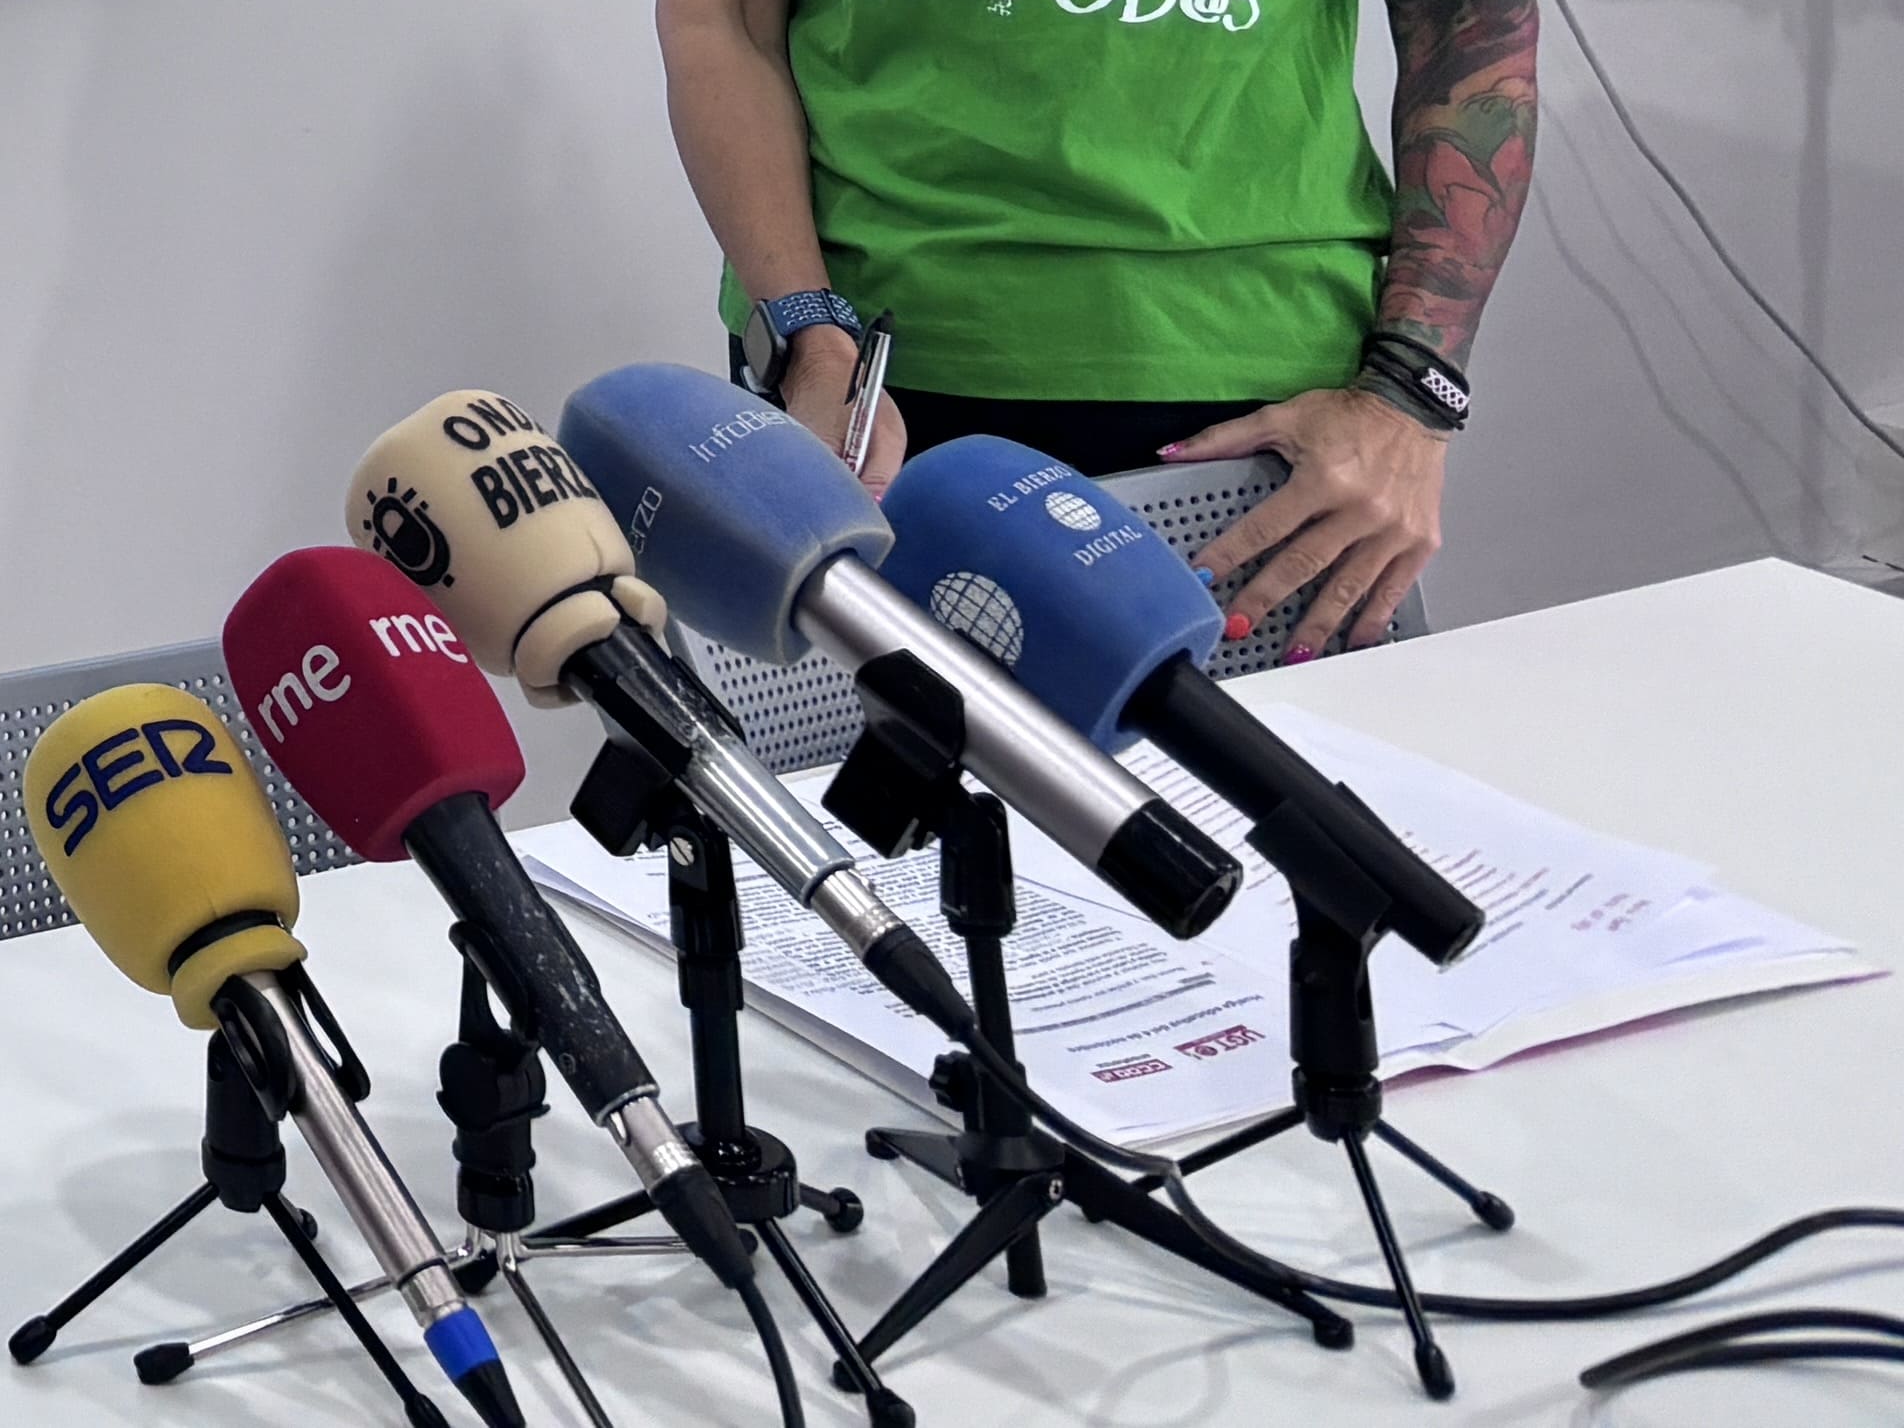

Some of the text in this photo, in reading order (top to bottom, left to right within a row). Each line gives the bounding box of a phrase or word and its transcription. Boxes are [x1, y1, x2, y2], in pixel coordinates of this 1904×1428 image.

[443, 396, 545, 451] OND
[471, 445, 600, 529] BIERZ
[987, 464, 1073, 512] EL BIERZO
[1072, 525, 1143, 567] DIGITAL
[369, 613, 469, 664] rne
[258, 644, 352, 744] rne
[46, 719, 233, 857] SER
